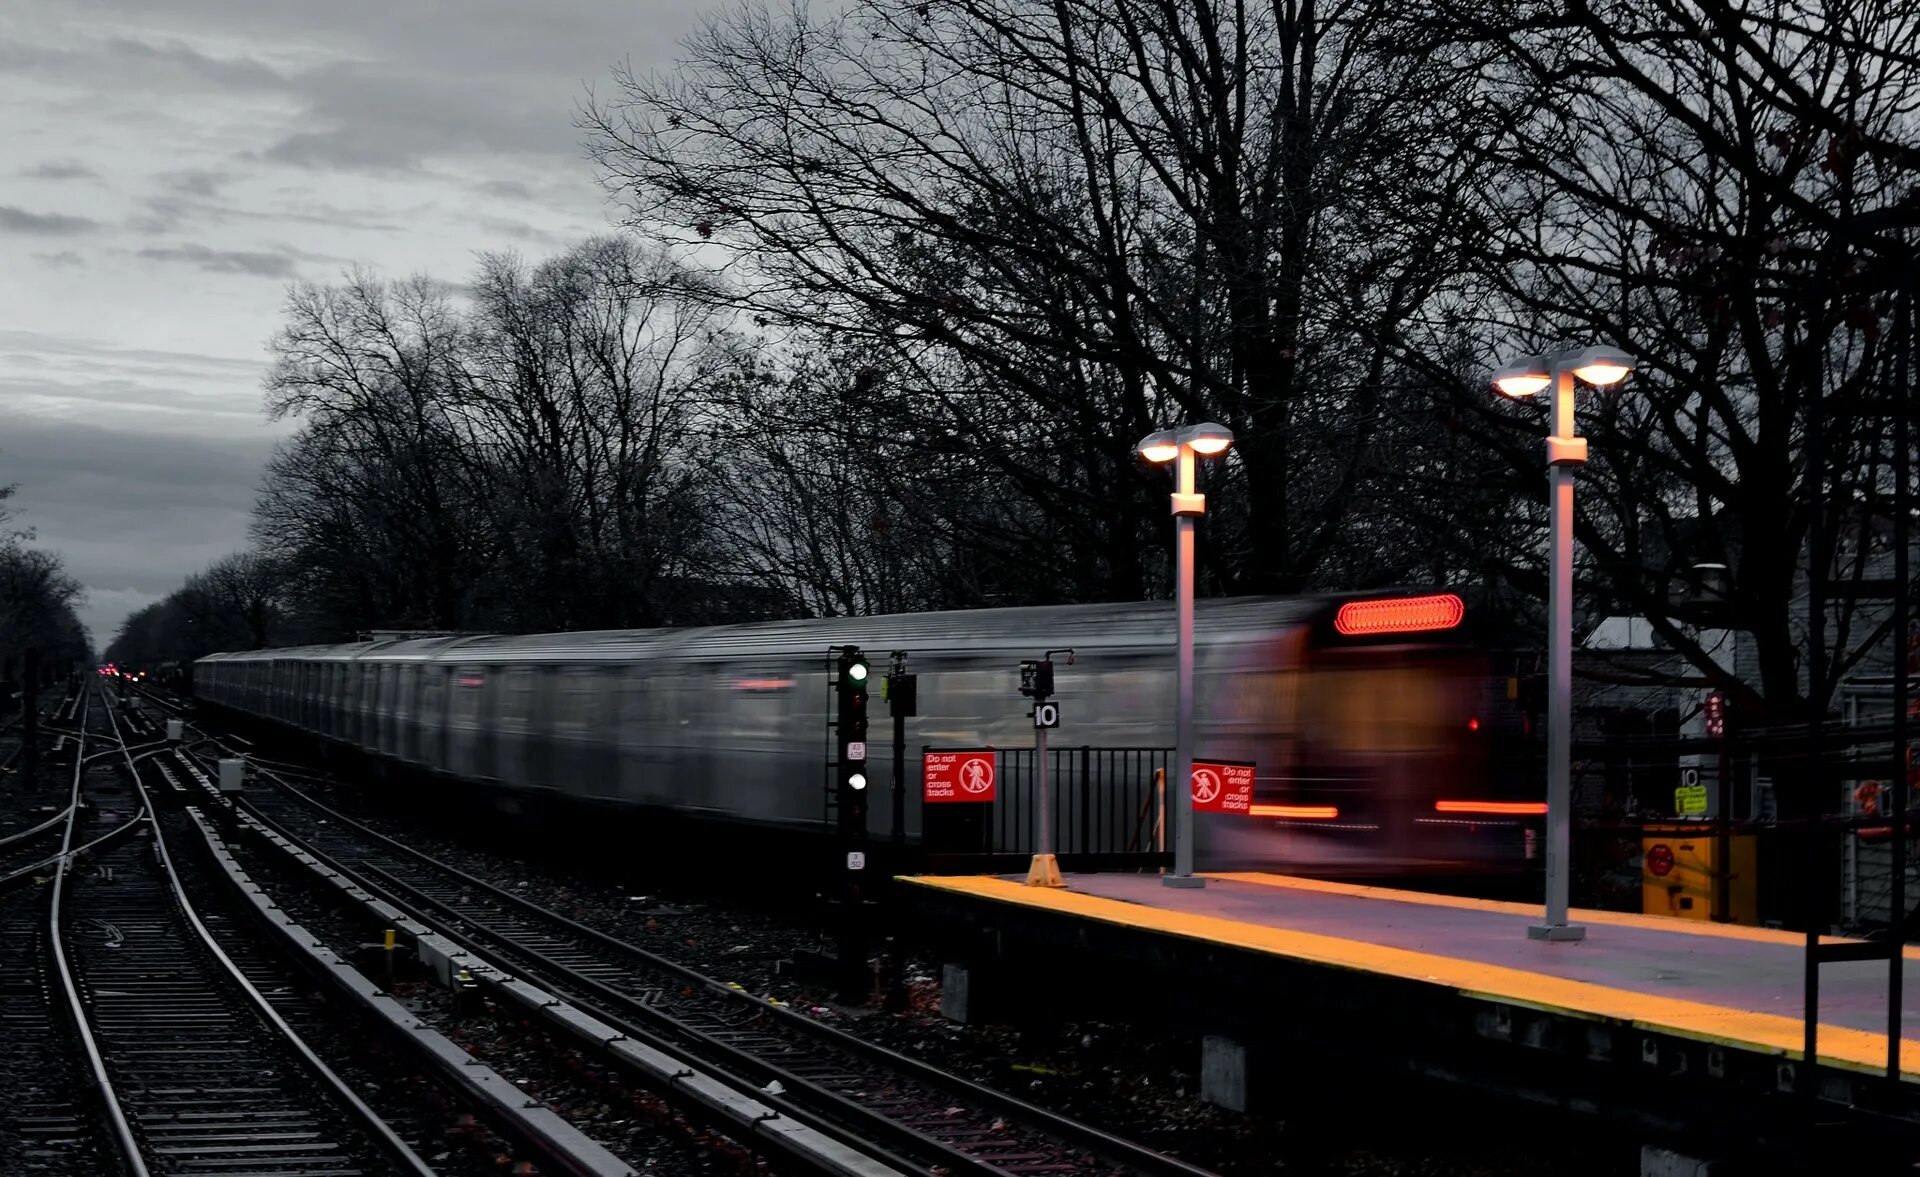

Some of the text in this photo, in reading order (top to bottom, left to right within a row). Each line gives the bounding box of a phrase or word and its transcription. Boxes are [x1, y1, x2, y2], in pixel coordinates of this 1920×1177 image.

[1036, 705, 1056, 725] 10
[926, 755, 957, 763] Do not
[927, 764, 950, 772] enter
[1223, 767, 1252, 777] Do not
[1228, 777, 1251, 785] enter
[1681, 769, 1698, 787] 10
[927, 789, 955, 797] tracks
[1222, 801, 1248, 809] tracks
